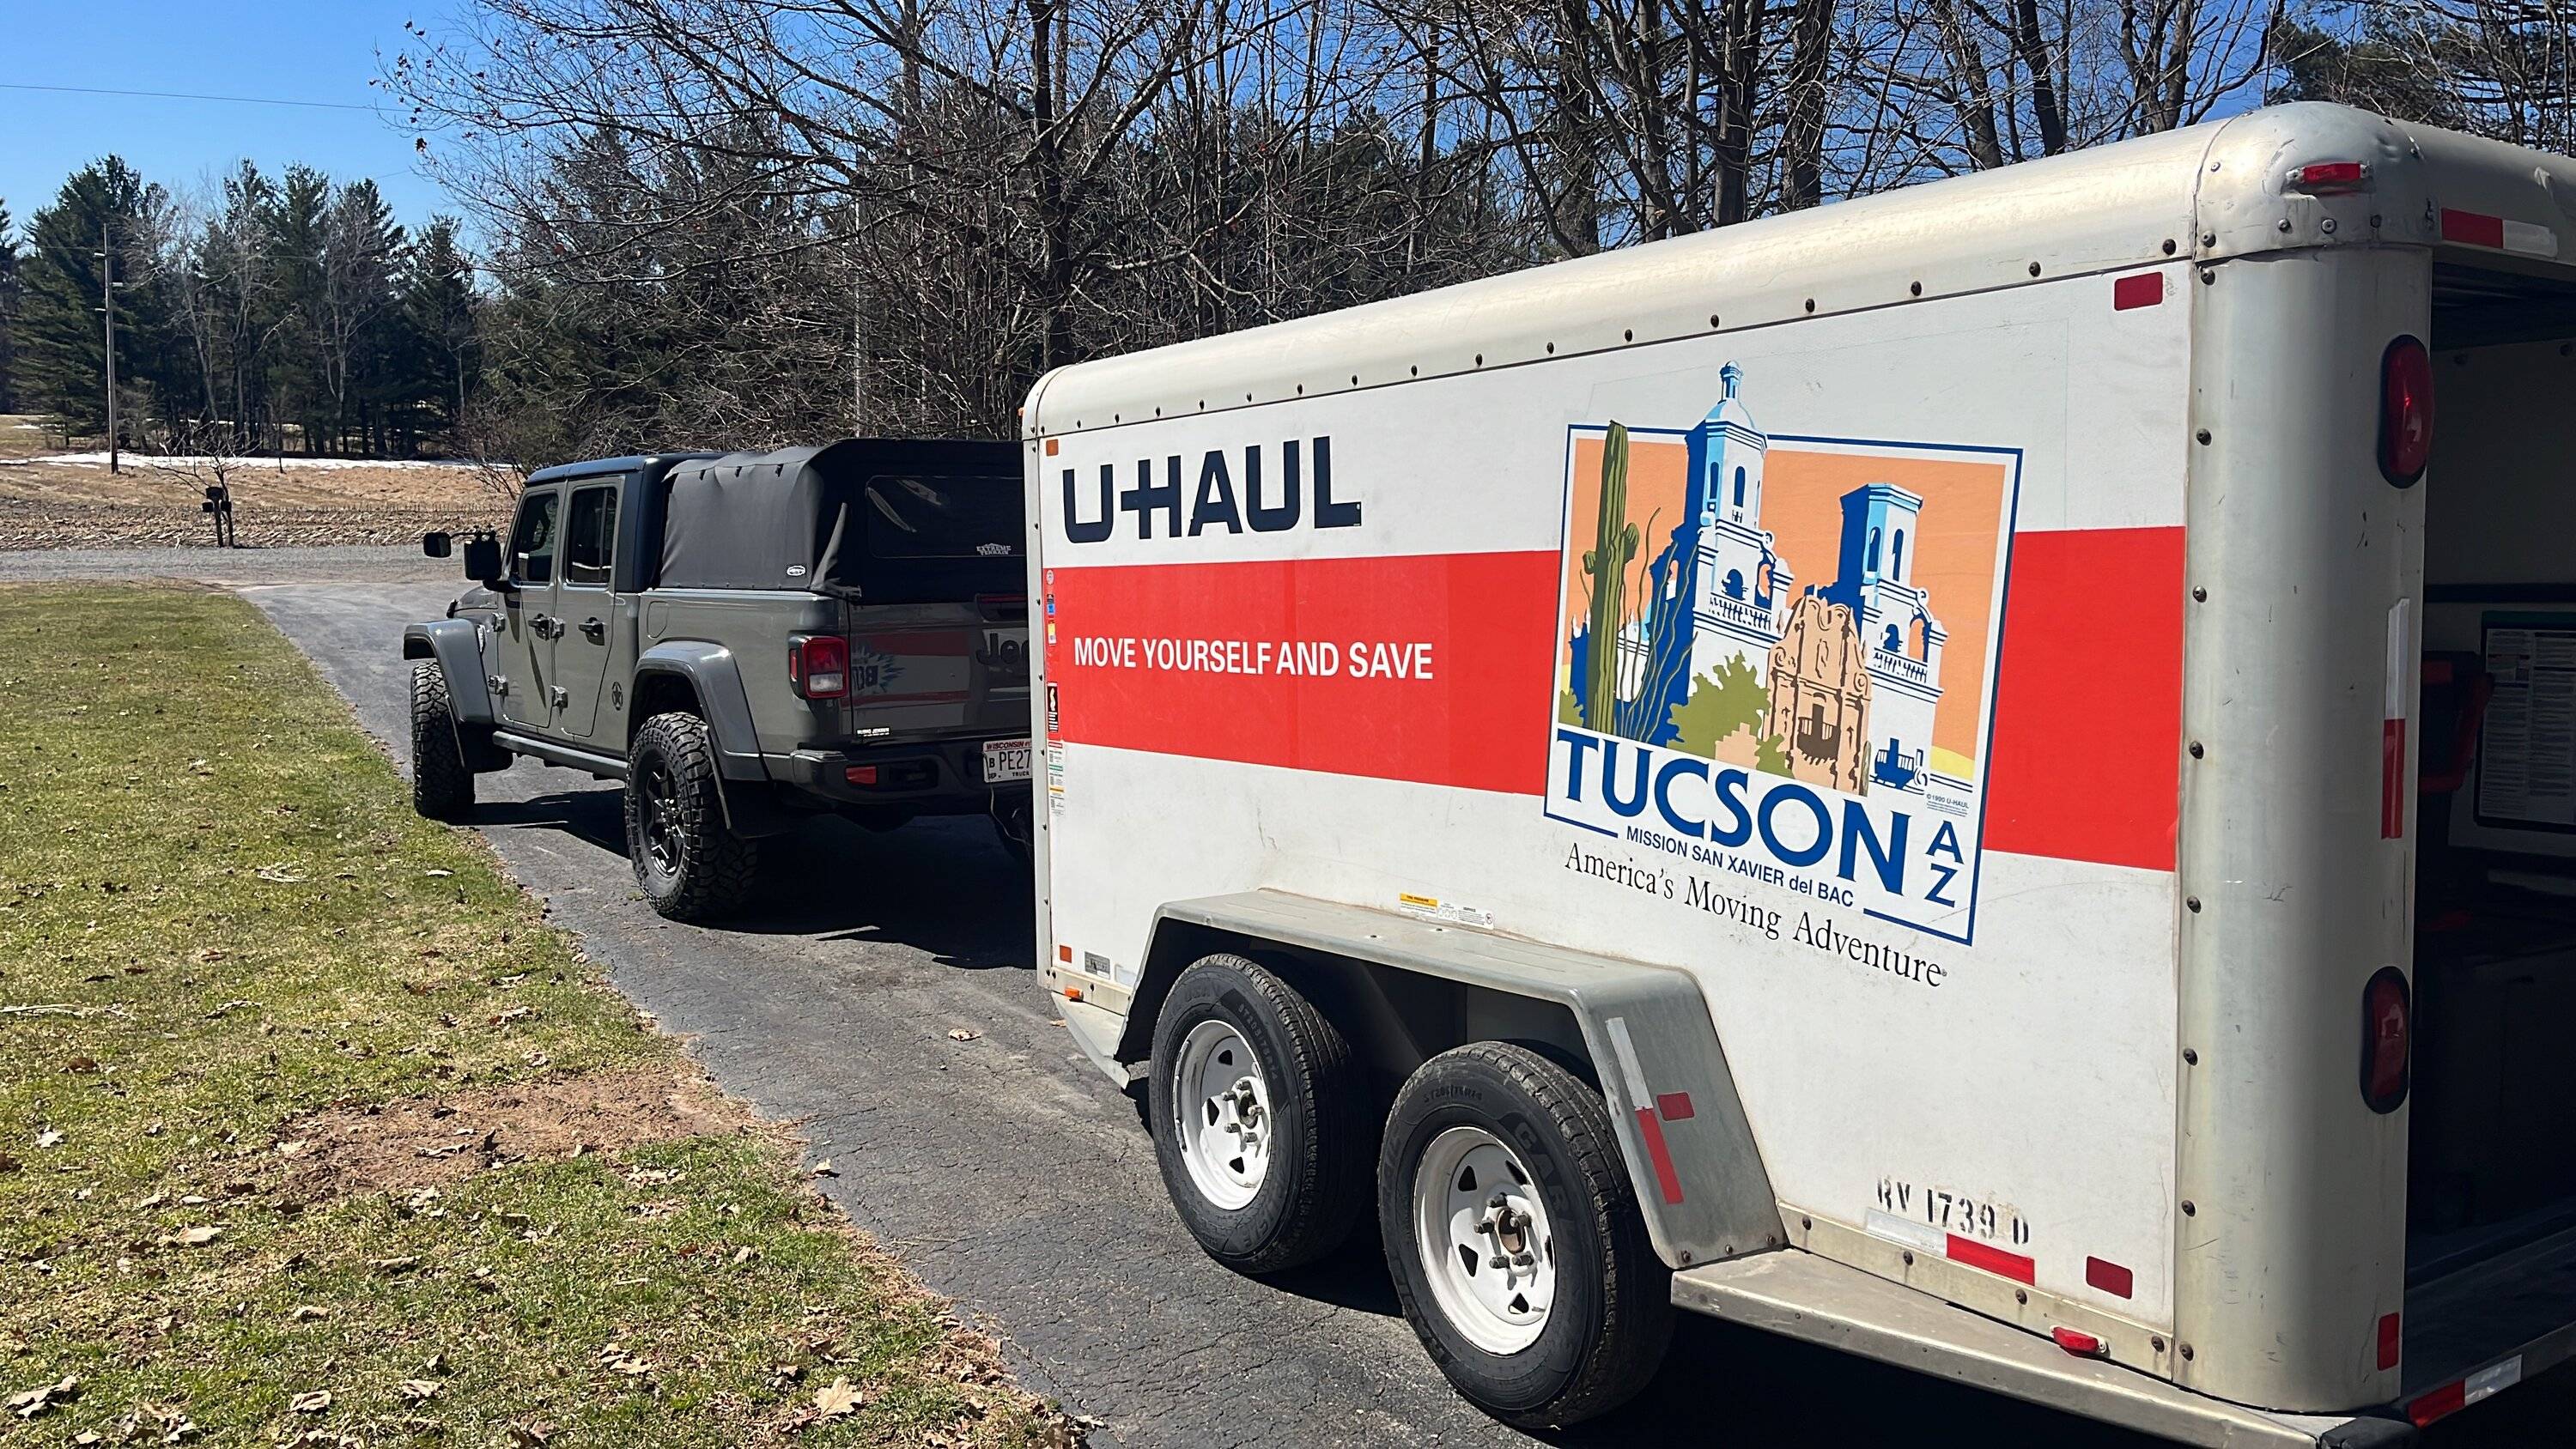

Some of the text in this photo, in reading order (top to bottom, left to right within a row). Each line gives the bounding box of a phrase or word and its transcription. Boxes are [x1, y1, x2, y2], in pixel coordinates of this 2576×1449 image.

[1062, 435, 1362, 544] U-HAUL
[1073, 637, 1433, 680] MOVE YOURSELF AND SAVE
[986, 742, 1024, 750] WISCONSIN
[989, 758, 995, 767] B
[1557, 728, 1910, 895] TUCSON
[1564, 842, 1674, 900] America's
[1685, 876, 1783, 941] Moving
[1626, 824, 1855, 907] MISSION SAN XAVIER del BAC
[1926, 1188, 1996, 1240] 1739
